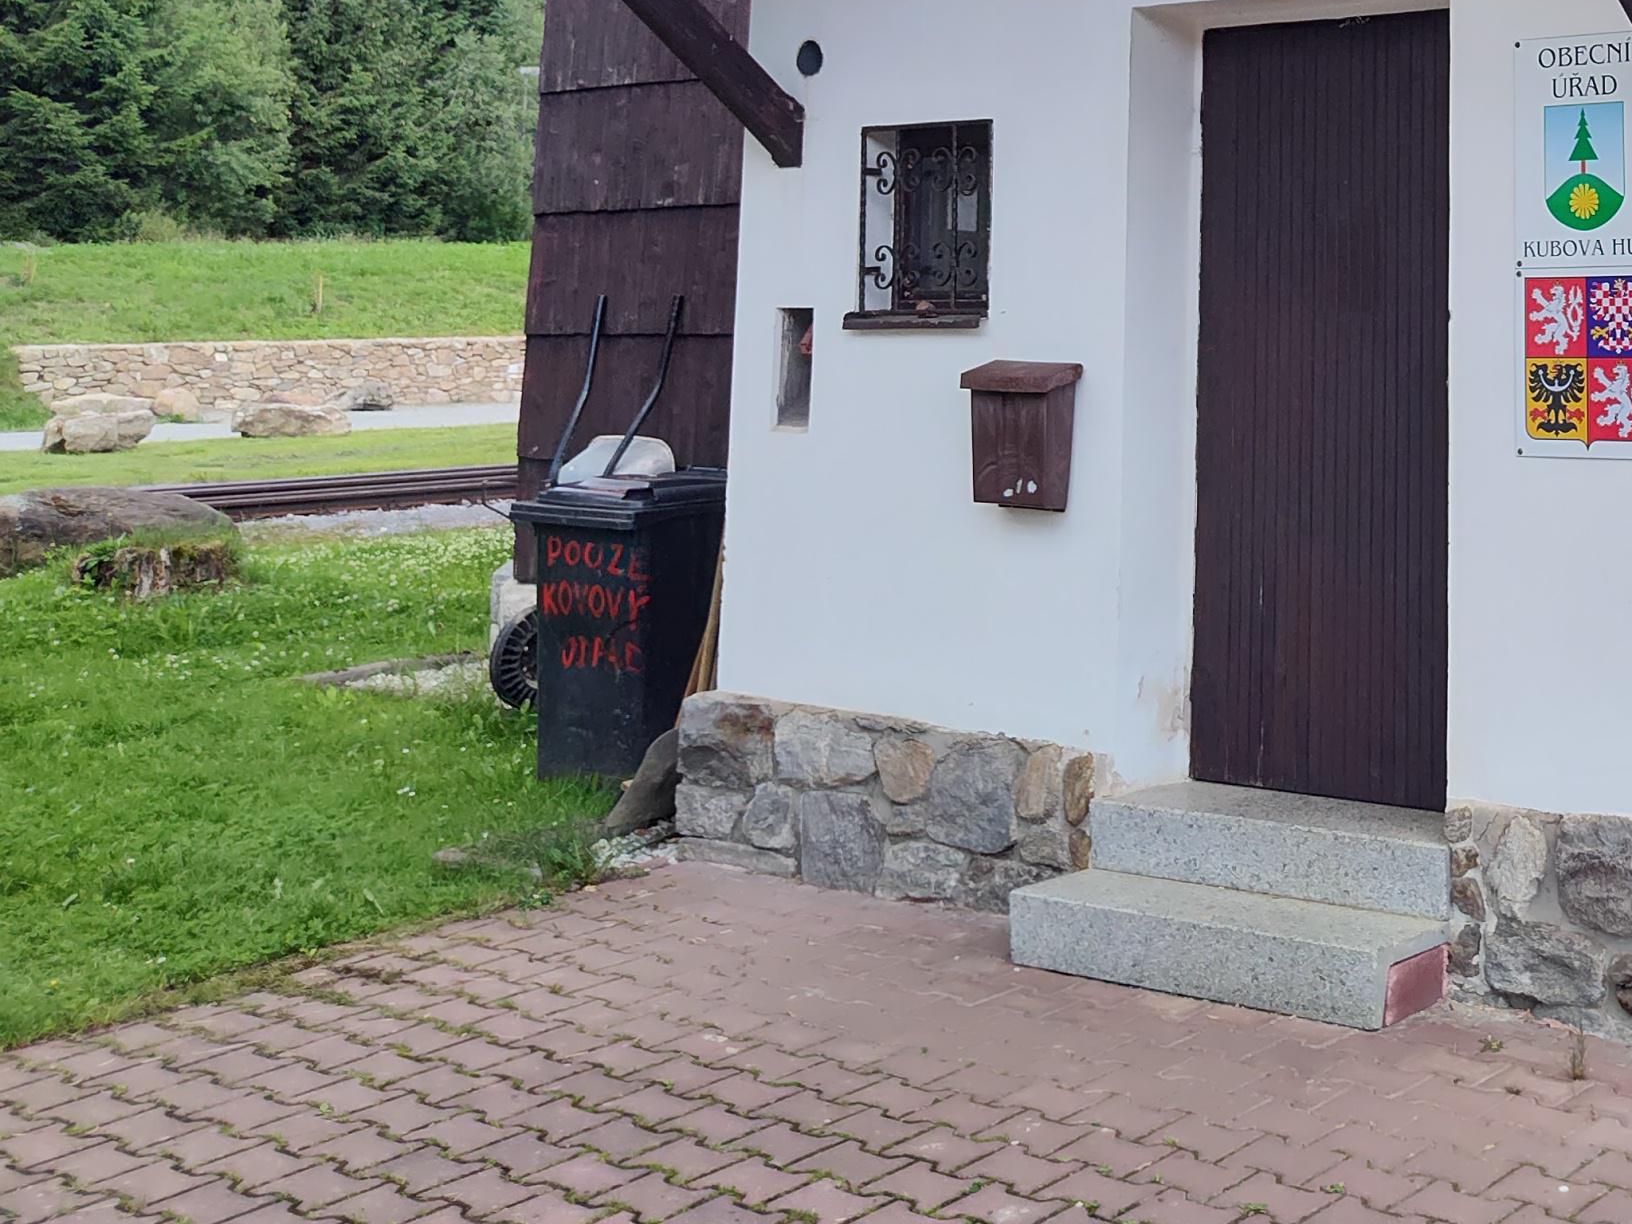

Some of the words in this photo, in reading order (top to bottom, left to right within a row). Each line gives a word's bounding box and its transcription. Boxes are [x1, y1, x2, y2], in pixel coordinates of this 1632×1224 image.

[1538, 37, 1631, 68] OBECNÍ
[1552, 72, 1617, 98] ÚŘAD
[1523, 239, 1605, 257] KUBOVA
